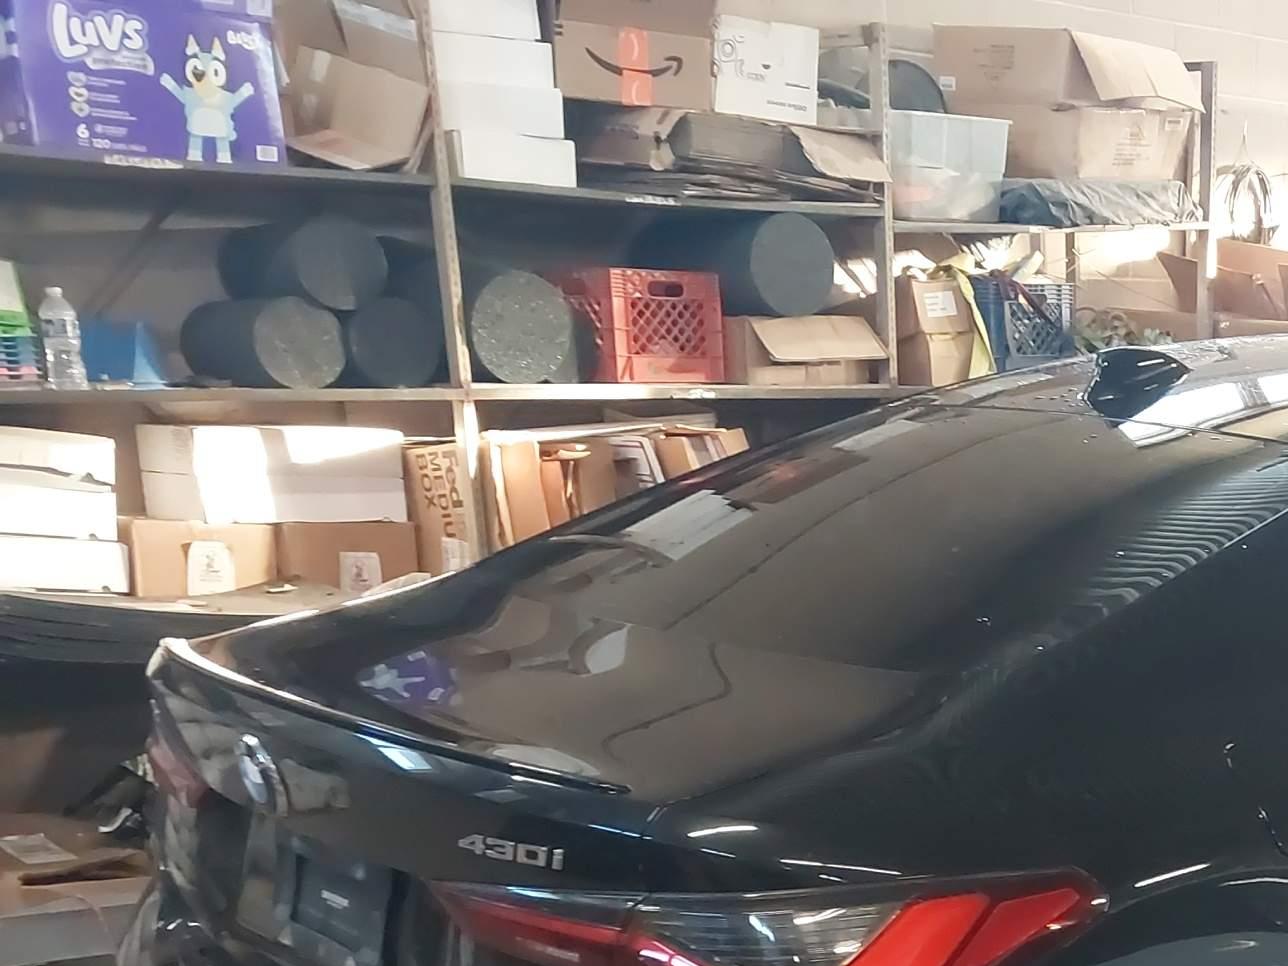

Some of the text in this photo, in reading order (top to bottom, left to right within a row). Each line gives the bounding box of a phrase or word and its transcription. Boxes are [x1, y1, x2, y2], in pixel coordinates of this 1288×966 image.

[76, 123, 90, 138] 6
[415, 454, 437, 508] BOX
[428, 451, 457, 537] MEDIU
[458, 833, 564, 871] 430i
